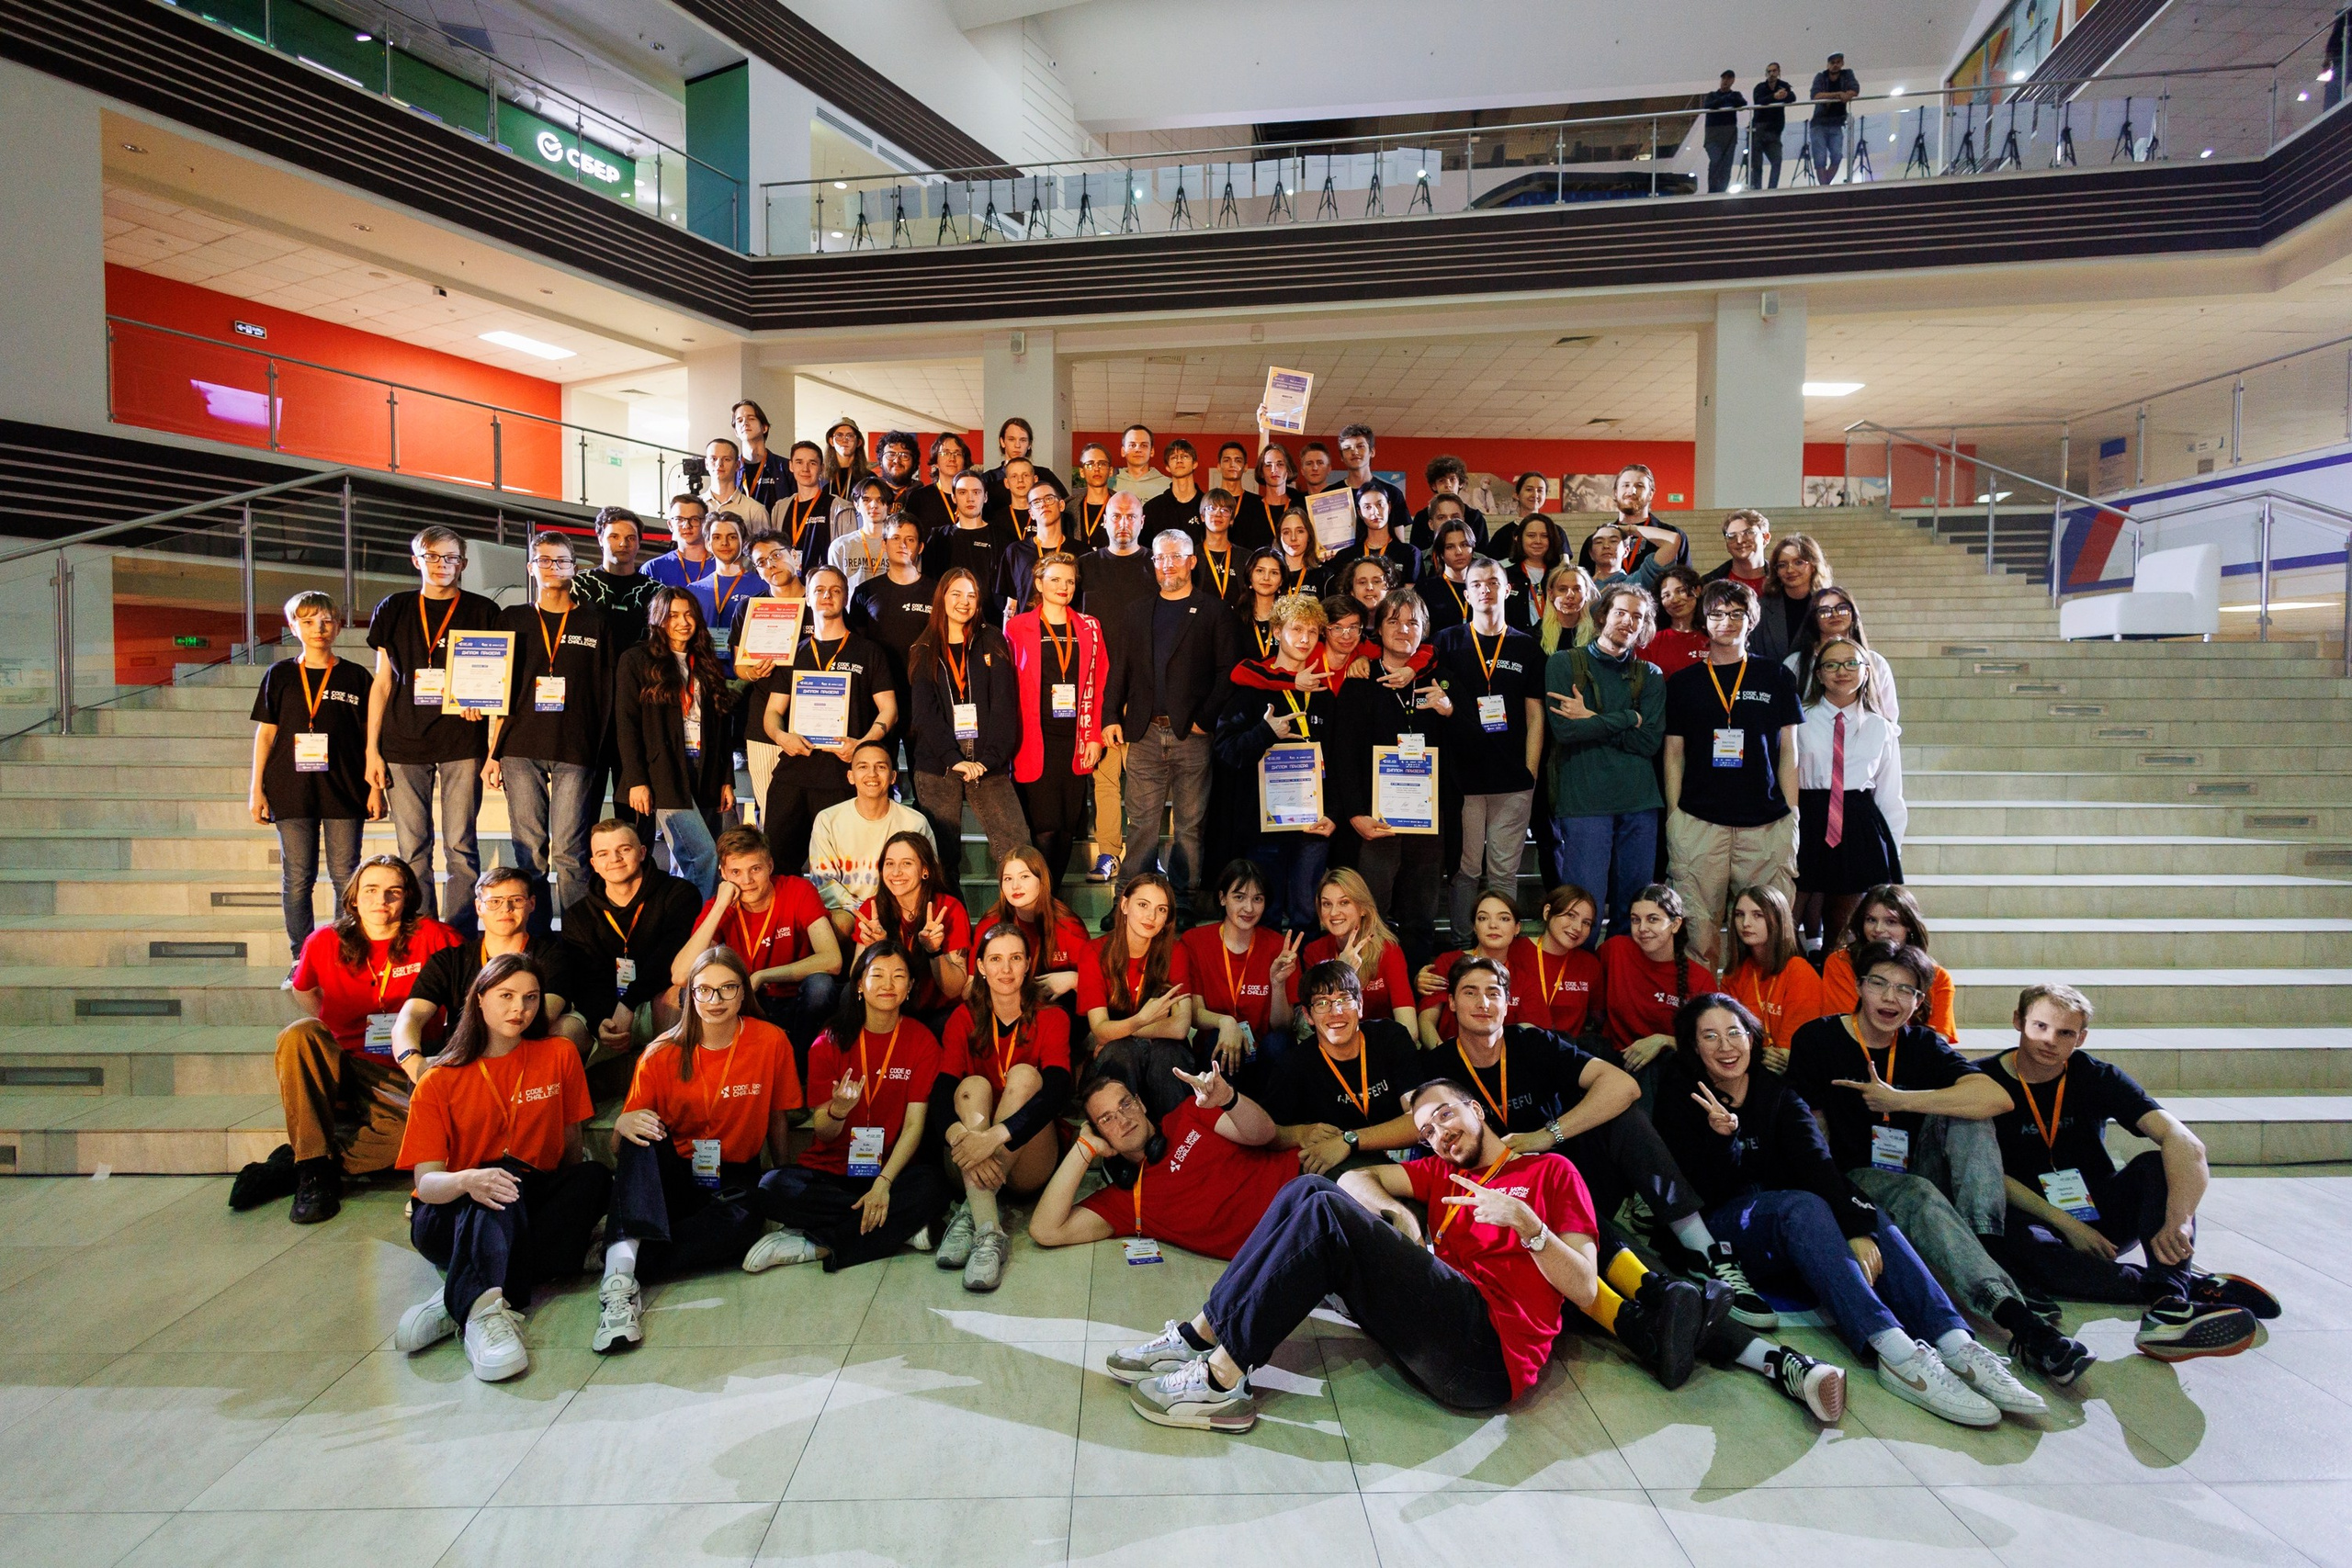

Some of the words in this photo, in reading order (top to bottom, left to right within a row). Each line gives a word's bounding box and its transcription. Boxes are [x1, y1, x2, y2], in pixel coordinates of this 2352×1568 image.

[566, 148, 620, 183] СБЕР
[843, 557, 868, 568] DREAM
[526, 1087, 543, 1096] CODE
[1173, 1144, 1186, 1160] CODE
[1178, 1132, 1202, 1163] CHALLENGE
